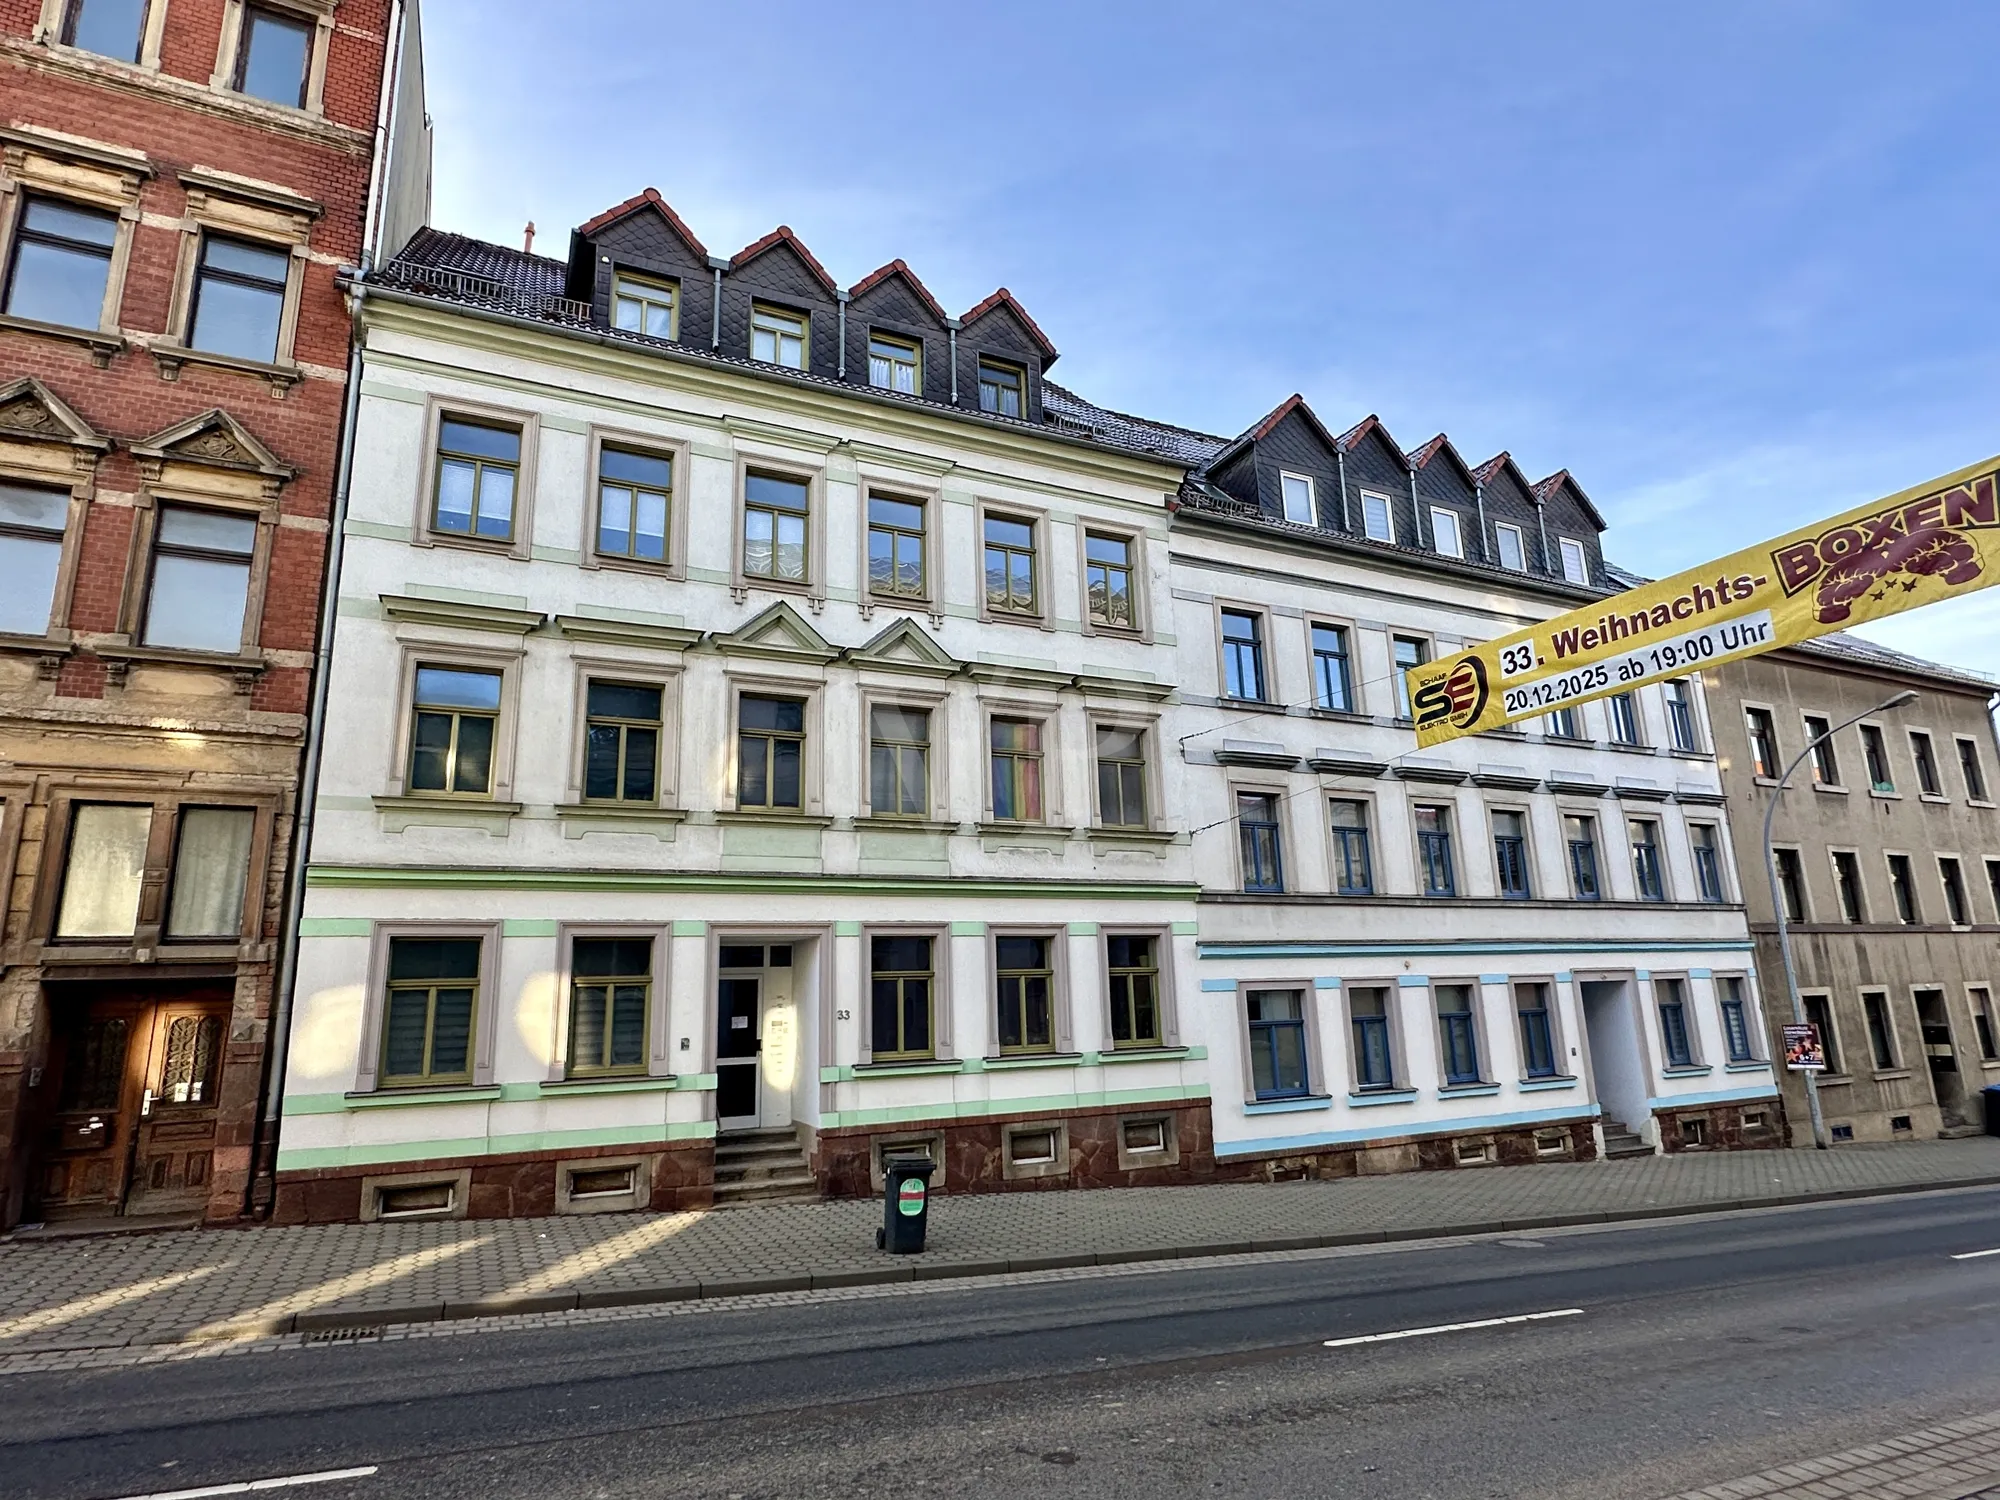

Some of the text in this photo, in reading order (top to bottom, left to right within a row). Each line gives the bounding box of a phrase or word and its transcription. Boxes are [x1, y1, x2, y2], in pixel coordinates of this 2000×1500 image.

[1776, 473, 1997, 590] BOXEN
[1502, 575, 1767, 674] 33. Weihnachts-
[1505, 620, 1768, 713] 20.12.2025 ab 19:00 Uhr
[1420, 717, 1448, 731] ELEKTRO
[837, 1010, 850, 1020] 33
